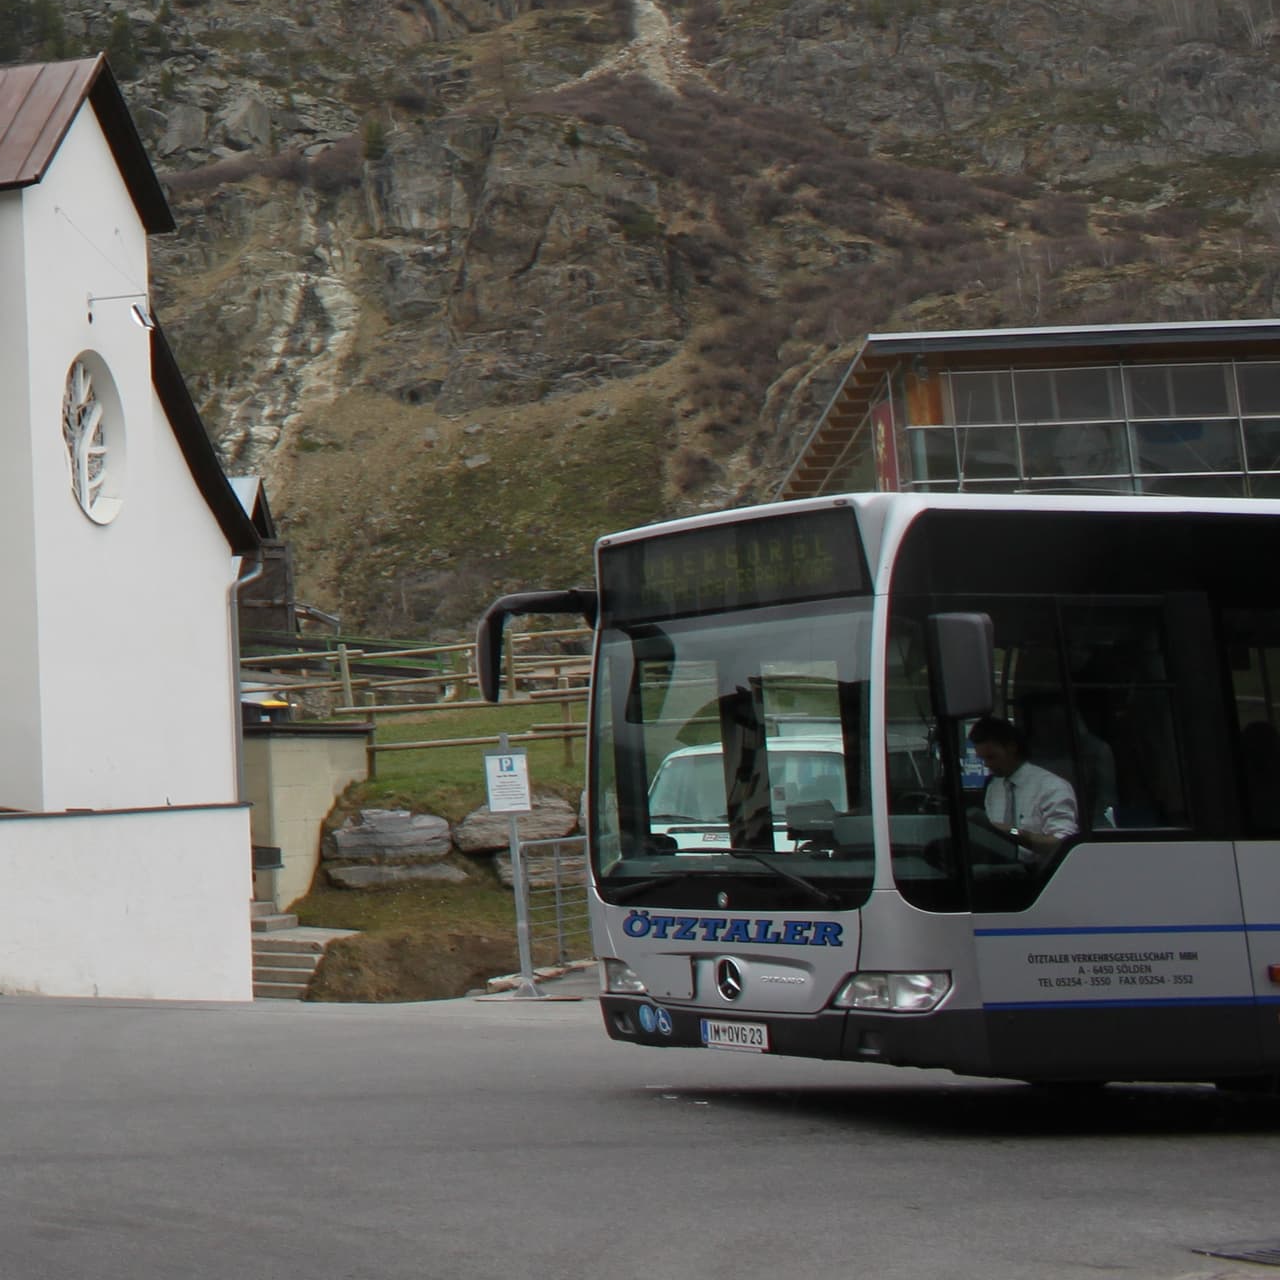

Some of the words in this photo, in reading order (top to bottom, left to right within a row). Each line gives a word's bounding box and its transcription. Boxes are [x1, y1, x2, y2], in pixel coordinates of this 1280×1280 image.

[501, 758, 512, 771] P
[622, 910, 844, 947] ÖTZTALER
[1027, 953, 1069, 964] ÖTZTALER
[1071, 952, 1174, 963] VERKEHRSGESELLSCHAFT
[1092, 965, 1114, 974] 6450
[1116, 964, 1152, 974] SÖLDEN
[1038, 978, 1053, 987] TEL
[1056, 977, 1082, 987] 05254
[1119, 976, 1137, 985] FAX
[1138, 975, 1165, 985] 05254
[709, 1024, 721, 1041] IM
[748, 1028, 763, 1045] 23
